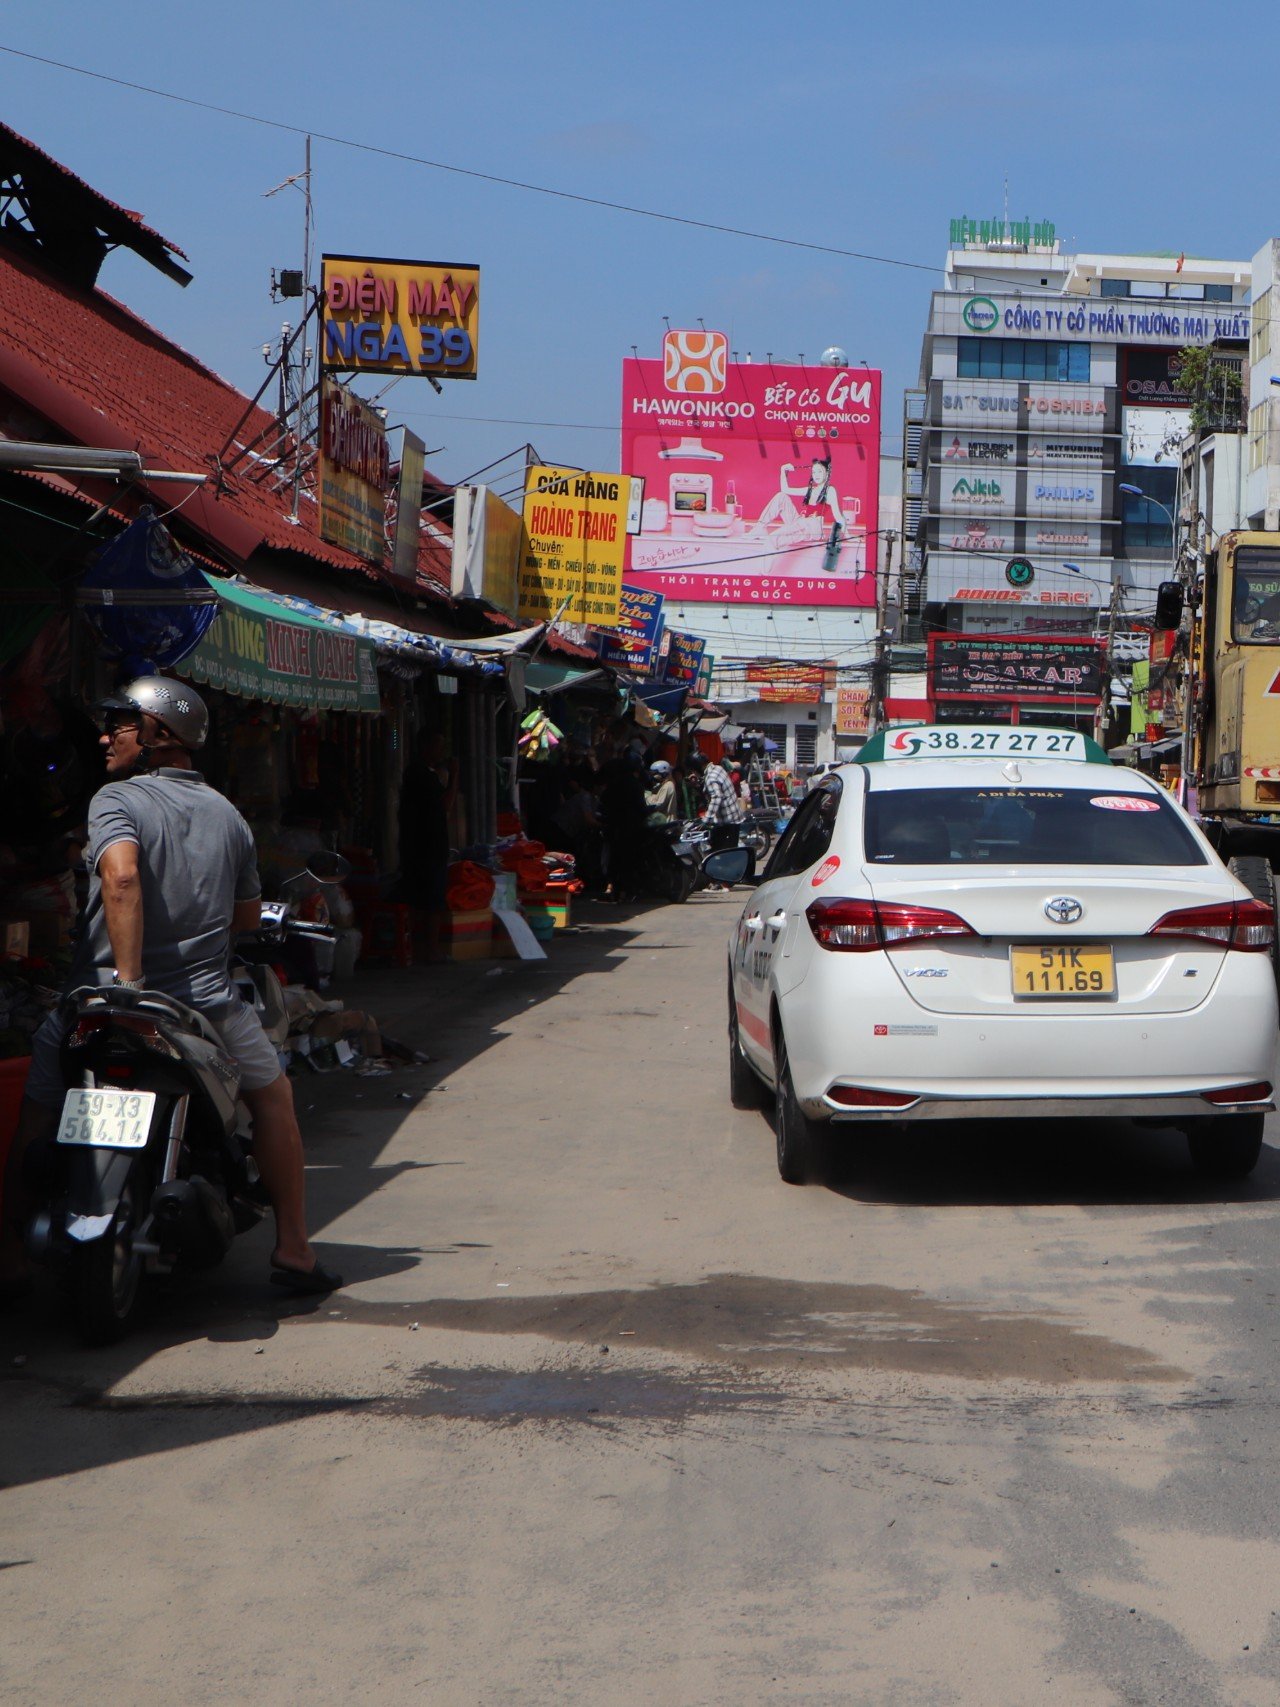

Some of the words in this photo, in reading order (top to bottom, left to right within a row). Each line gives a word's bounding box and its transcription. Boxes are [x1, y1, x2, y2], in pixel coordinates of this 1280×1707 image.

[327, 268, 394, 318] ĐIỆN
[408, 274, 477, 318] MÁY
[1004, 304, 1041, 331] CÔNG
[1046, 310, 1062, 331] TY
[1067, 302, 1086, 331] CỔ
[1089, 305, 1123, 334] PHẦN
[1128, 312, 1179, 336] THƯƠNG
[1183, 317, 1208, 343] MẠI
[1214, 311, 1249, 337] XUẤT
[327, 319, 411, 363] NGA
[419, 326, 471, 366] 39
[764, 382, 796, 406] BẾP
[943, 395, 1019, 411] SASUNG
[633, 397, 755, 419] HAWONKOO
[1024, 397, 1107, 414] TOSHIBA
[765, 410, 798, 422] CHỌN
[801, 411, 870, 424] HAWONKOO
[968, 442, 1014, 452] MITSUBISHI
[968, 451, 1008, 460] ELECTRIC
[537, 471, 569, 496] CỬA
[574, 473, 618, 500] HÀNG
[1035, 485, 1094, 502] PHILIPS
[578, 510, 617, 542] TRANG
[952, 536, 1006, 549] LIFAN
[661, 575, 694, 585] THỜI
[704, 577, 751, 587] TRANG
[762, 579, 787, 588] GIA
[797, 580, 837, 590] DỤNG
[713, 587, 741, 598] HÀN
[751, 588, 792, 599] QUỐC
[226, 607, 265, 664] TÙNG
[266, 618, 311, 677] MINH
[316, 629, 357, 683] OANH
[928, 732, 1000, 750] 38.27
[1008, 734, 1038, 751] 27
[1046, 735, 1076, 752] 27
[1040, 947, 1083, 968] 51K
[903, 967, 949, 978] VIOS
[1026, 970, 1103, 991] 111.69
[78, 1094, 141, 1117] 59-X3
[64, 1117, 142, 1143] 584.14
